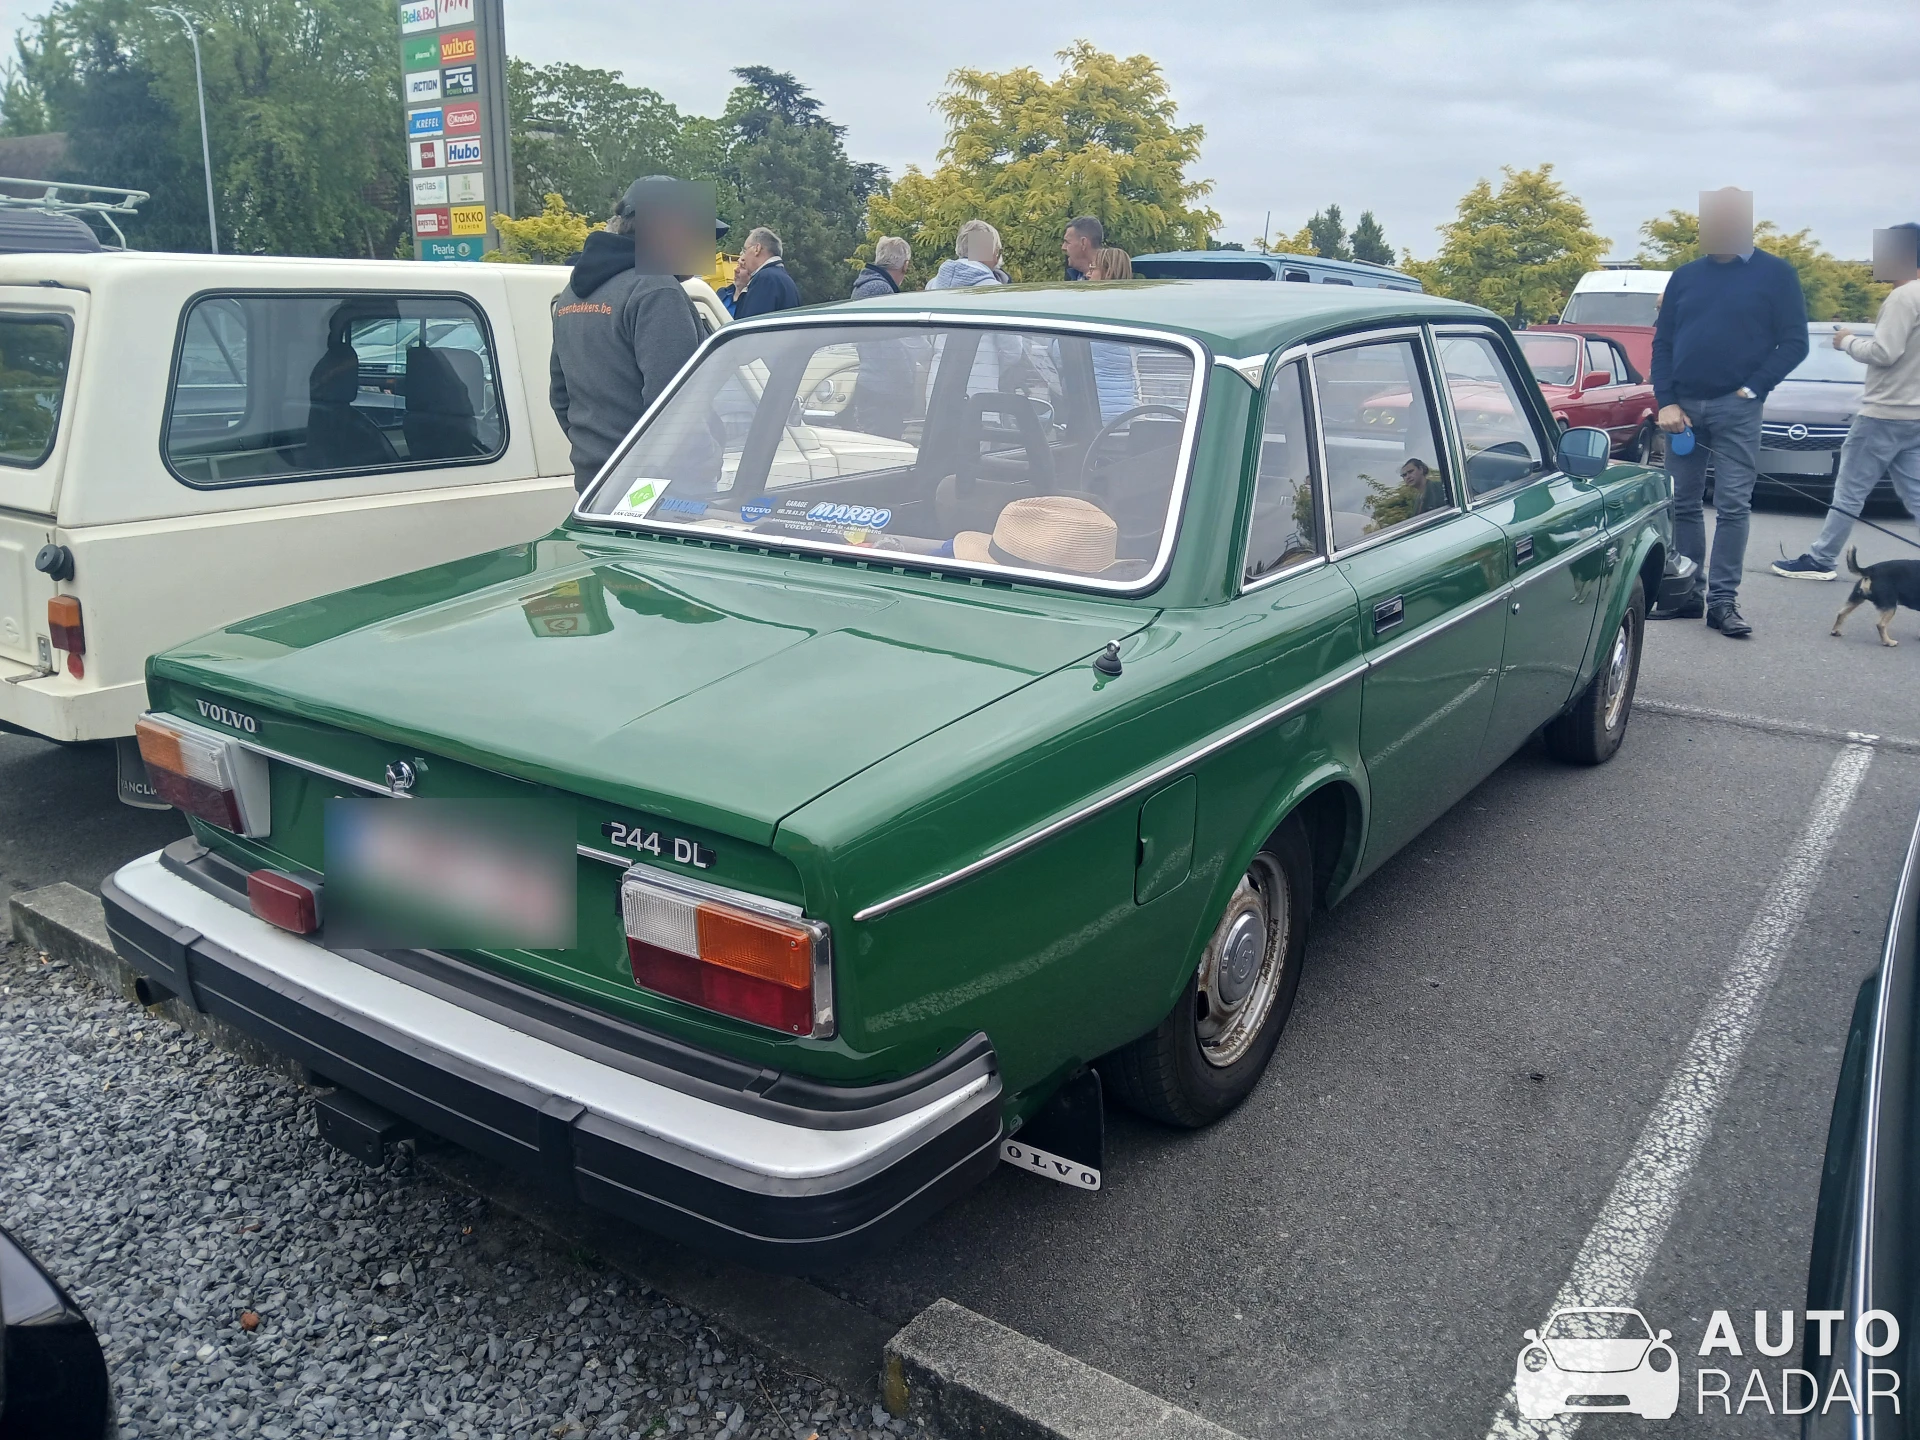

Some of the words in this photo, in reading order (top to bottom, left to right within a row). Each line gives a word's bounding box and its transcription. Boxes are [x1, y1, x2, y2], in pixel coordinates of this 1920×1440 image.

[402, 6, 435, 24] Bel&Bo
[441, 37, 474, 56] wibra
[413, 79, 437, 92] ACTION
[449, 144, 480, 160] Hubo
[415, 180, 436, 191] veritas
[432, 243, 455, 255] Pearle
[741, 505, 772, 514] VOLVO
[785, 500, 808, 508] GARAGE
[806, 502, 892, 529] MARBO
[784, 523, 813, 531] VOLVO
[820, 527, 855, 537] DEALER
[195, 699, 257, 735] VOLVO
[610, 822, 662, 859] 244
[673, 835, 710, 868] DL
[1006, 1145, 1097, 1185] OLVO
